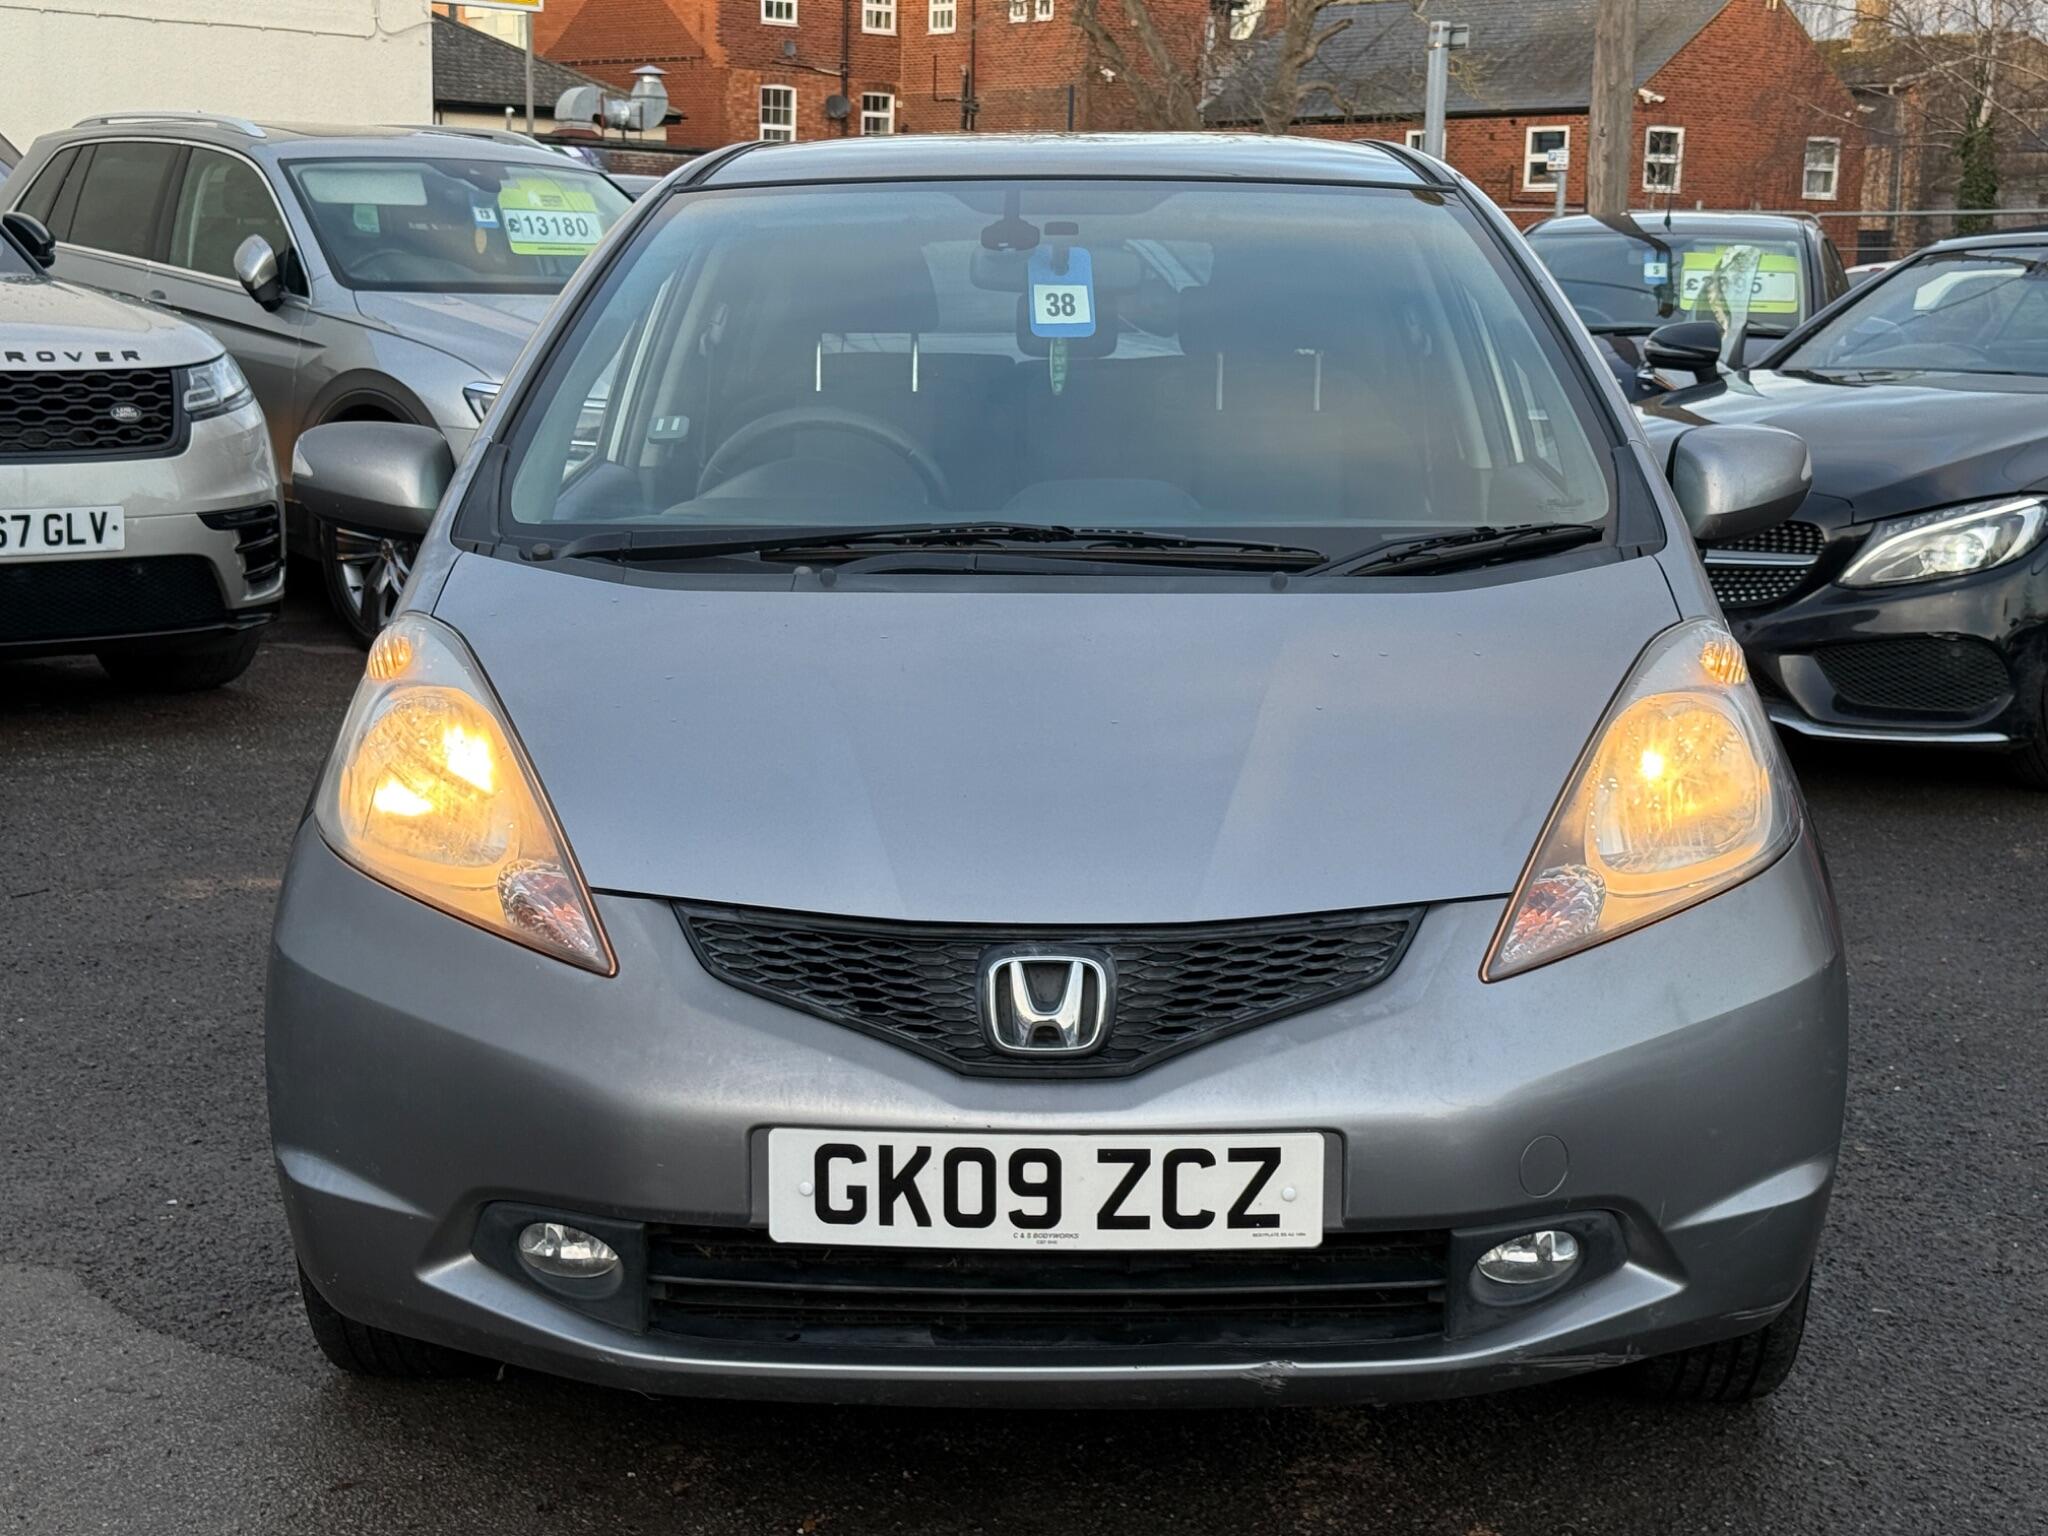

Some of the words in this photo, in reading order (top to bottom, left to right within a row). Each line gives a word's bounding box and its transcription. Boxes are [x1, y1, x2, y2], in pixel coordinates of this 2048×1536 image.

[508, 215, 589, 237] £13180
[1045, 292, 1076, 317] 38
[4, 350, 141, 362] ROVER
[43, 511, 107, 546] GLV
[814, 1143, 1062, 1230] GK09
[1097, 1146, 1282, 1230] ZCZ
